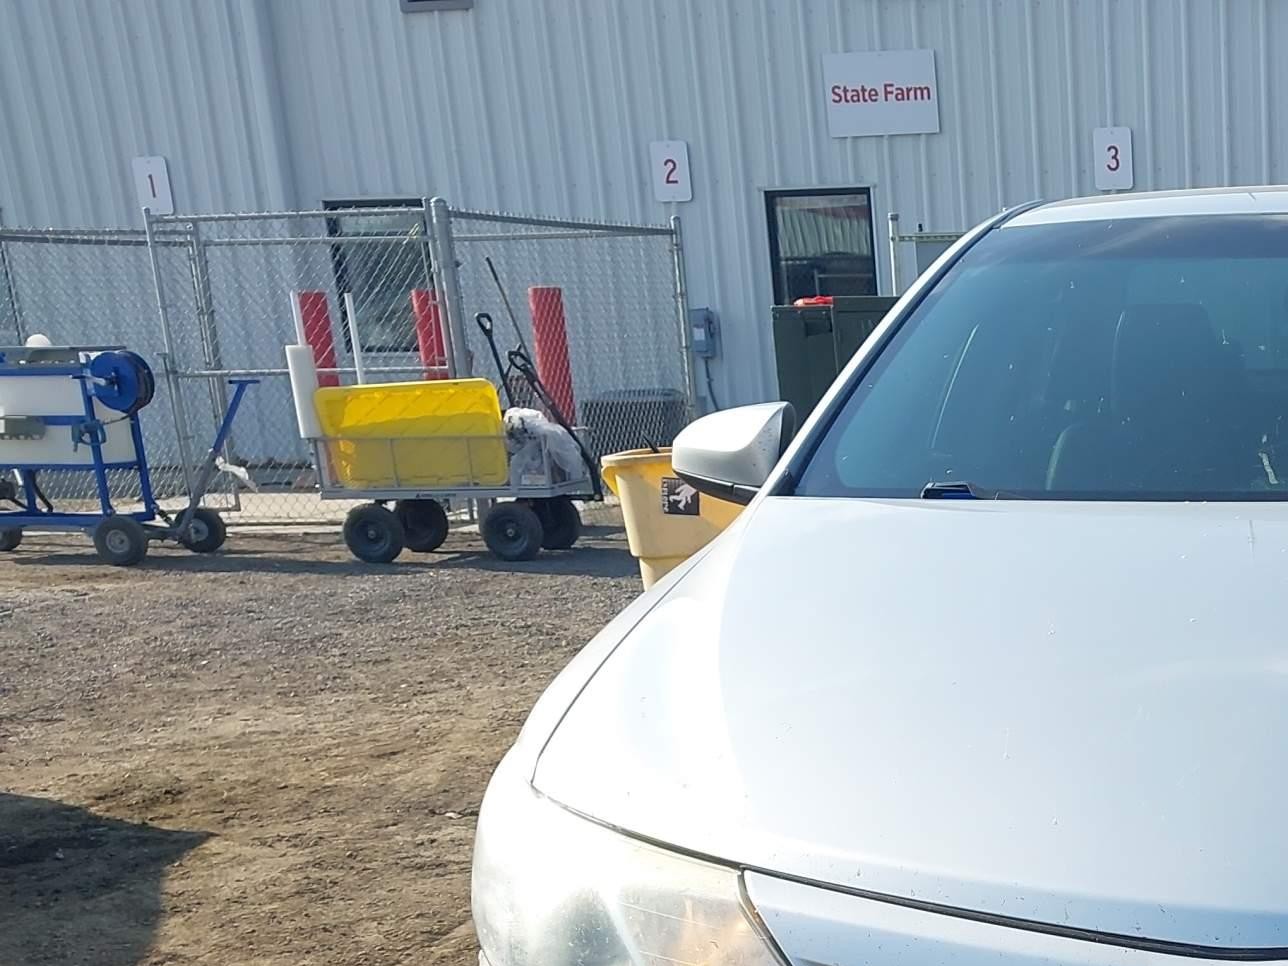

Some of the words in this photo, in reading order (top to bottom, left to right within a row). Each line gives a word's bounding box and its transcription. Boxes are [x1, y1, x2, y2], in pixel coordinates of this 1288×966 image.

[831, 85, 879, 103] State
[884, 83, 931, 102] Farm
[1106, 145, 1120, 172] 3
[663, 158, 679, 185] 2
[147, 174, 157, 198] 1
